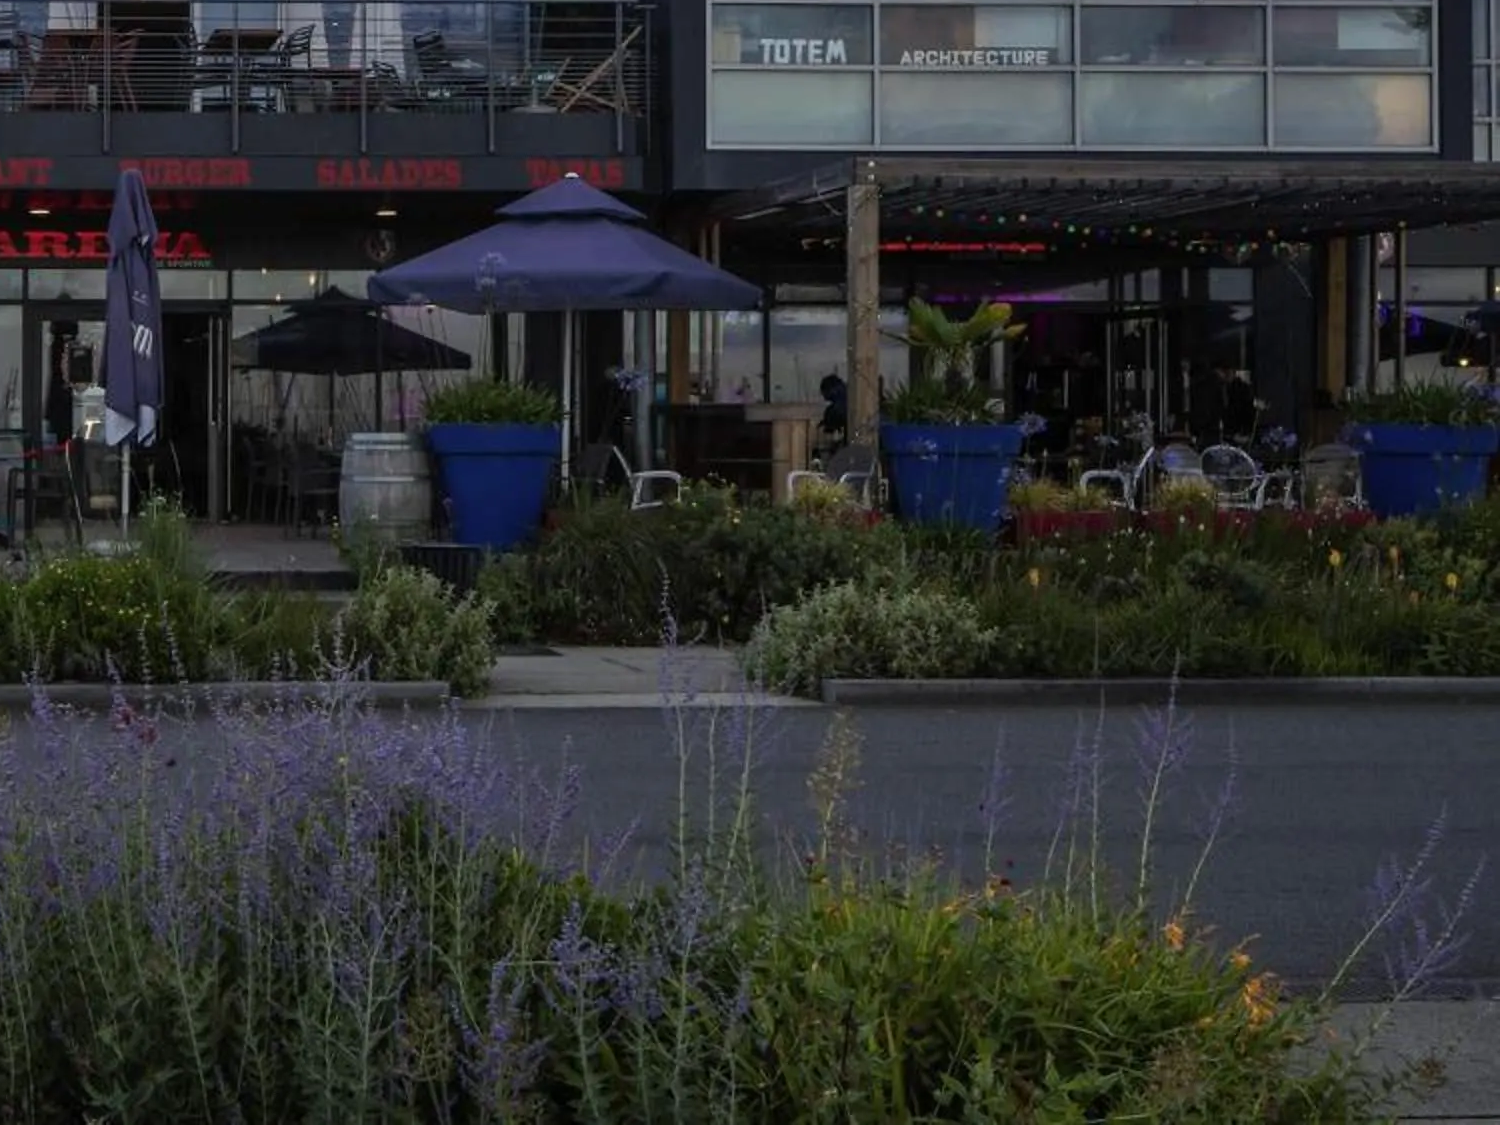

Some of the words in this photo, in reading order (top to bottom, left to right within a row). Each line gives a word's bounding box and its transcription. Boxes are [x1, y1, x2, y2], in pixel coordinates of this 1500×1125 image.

[759, 38, 847, 65] TOTEM
[900, 49, 1049, 66] ARCHITECTURE
[316, 158, 463, 188] SALADES
